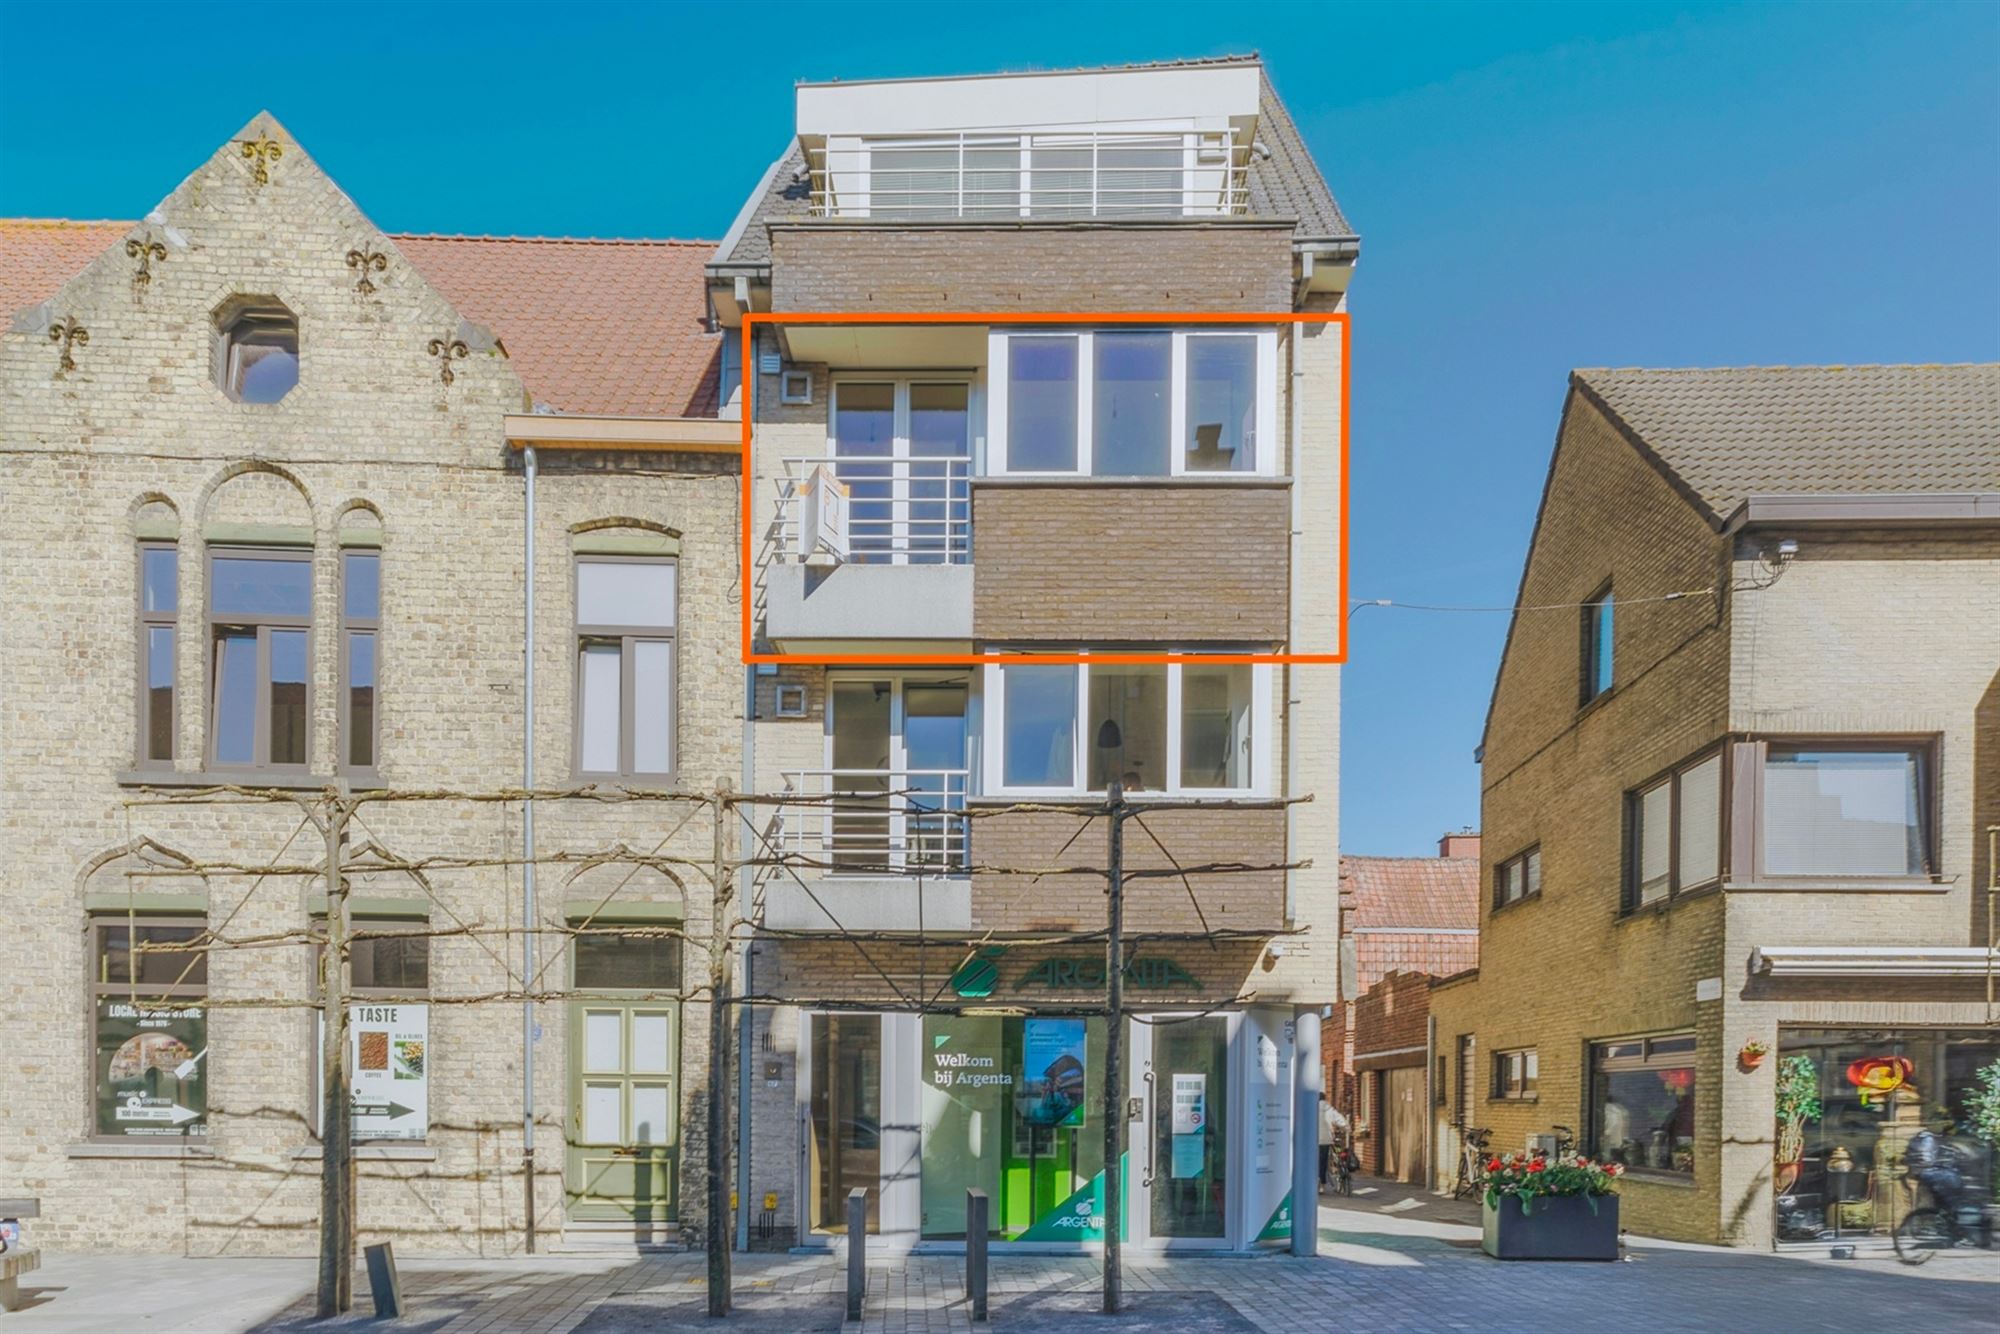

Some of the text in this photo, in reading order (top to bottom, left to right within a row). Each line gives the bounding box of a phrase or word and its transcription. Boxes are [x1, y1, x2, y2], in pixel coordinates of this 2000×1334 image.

[1012, 957, 1205, 991] ARGNTA
[359, 1007, 398, 1022] TASTE
[934, 1053, 993, 1067] Welkom
[934, 1070, 1013, 1088] bij Argenta
